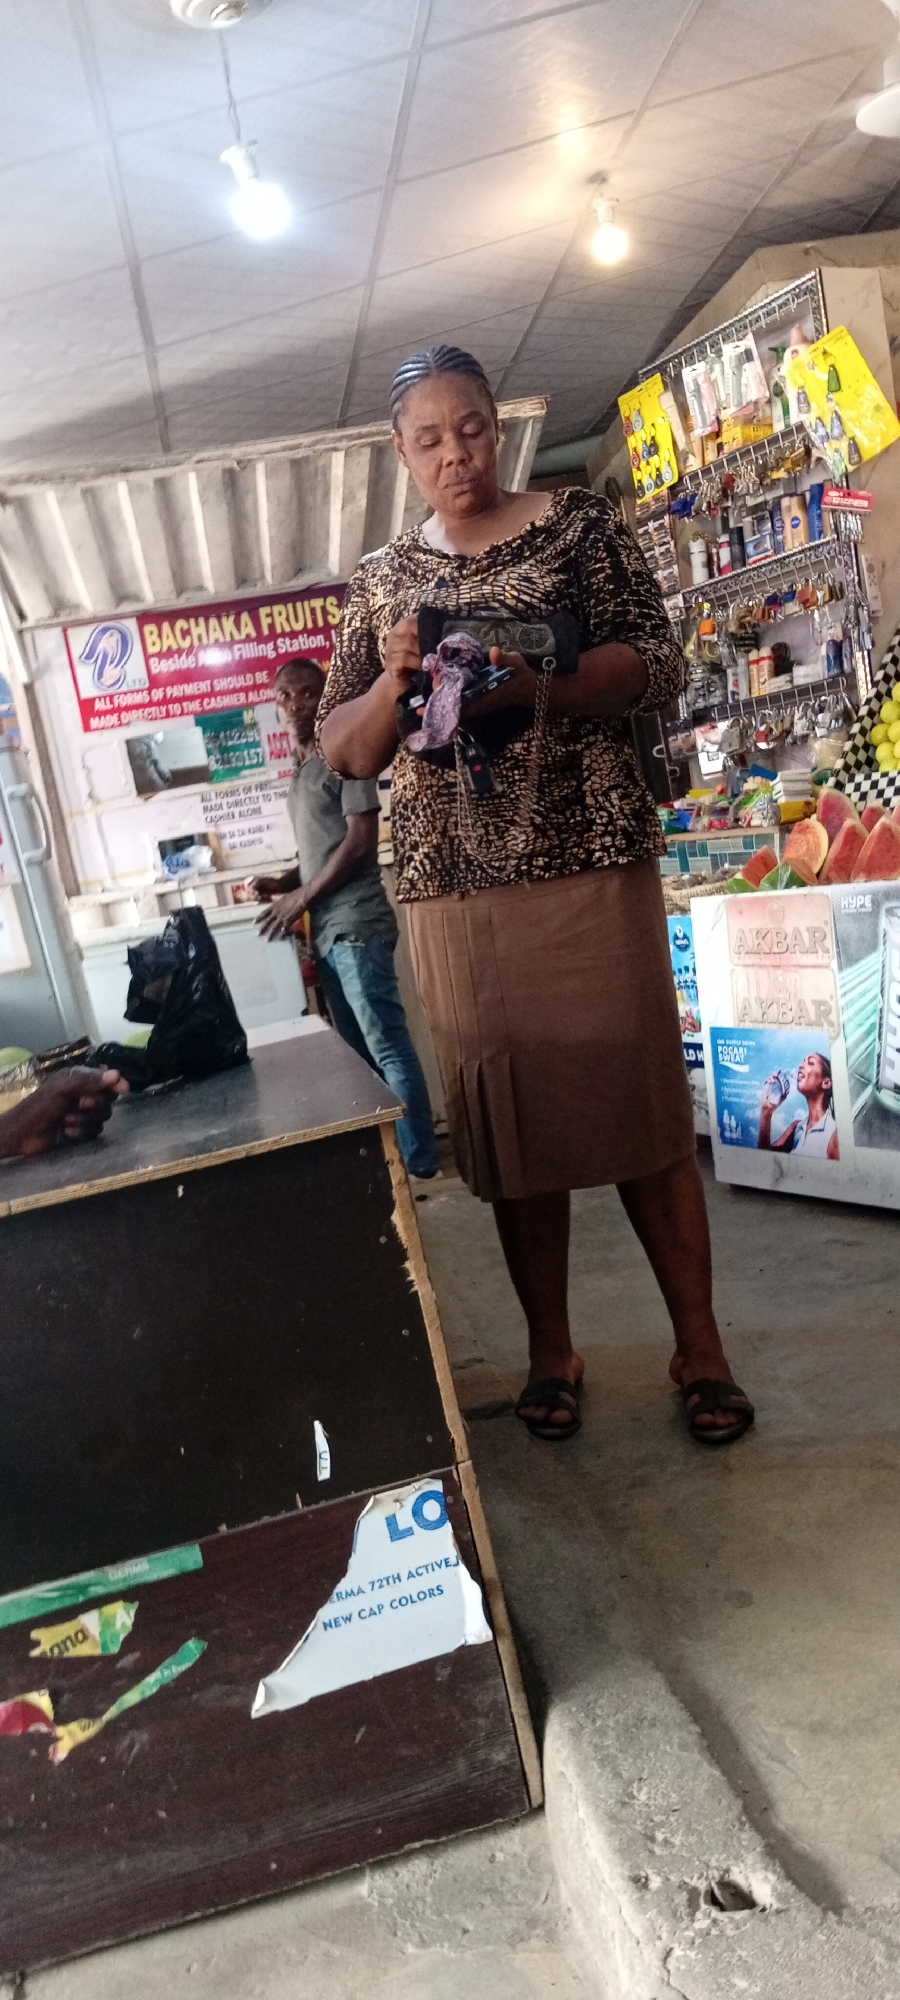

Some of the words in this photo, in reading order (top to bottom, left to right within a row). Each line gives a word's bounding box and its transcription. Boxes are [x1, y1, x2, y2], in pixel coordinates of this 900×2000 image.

[143, 612, 257, 655] BACHAKA
[259, 596, 342, 637] FRUITS
[149, 652, 197, 674] Beside
[233, 641, 277, 660] Filling
[277, 633, 330, 654] Station,
[94, 696, 113, 712] ALL
[113, 690, 150, 709] FORMS
[151, 688, 165, 702] OF
[165, 680, 211, 699] PAYMENT
[213, 673, 254, 692] SHOULD
[255, 670, 269, 684] BE
[90, 713, 120, 730] MADE
[121, 705, 167, 725] DIRECTLY
[168, 703, 181, 717] TO
[182, 699, 203, 714] THE
[203, 692, 246, 709] CASHIER
[248, 688, 278, 703] ALON
[201, 792, 214, 803] ALL
[215, 788, 241, 799] FORMS
[243, 785, 252, 795] OF
[203, 802, 224, 814] MADE
[226, 795, 260, 809] DIRECTLY
[262, 793, 272, 802] TO
[273, 789, 288, 800] THE
[205, 811, 236, 823] CASHIER
[238, 805, 262, 818] ALONE
[840, 894, 872, 909] HYPE
[733, 926, 830, 954] AKBAR
[738, 997, 835, 1027] AKBAR
[717, 1045, 747, 1055] POCARI
[718, 1053, 745, 1062] SWEAT
[369, 1572, 402, 1591] 72TH
[322, 1613, 353, 1631] NEW
[358, 1603, 385, 1620] CAP
[389, 1584, 444, 1610] COLORS
